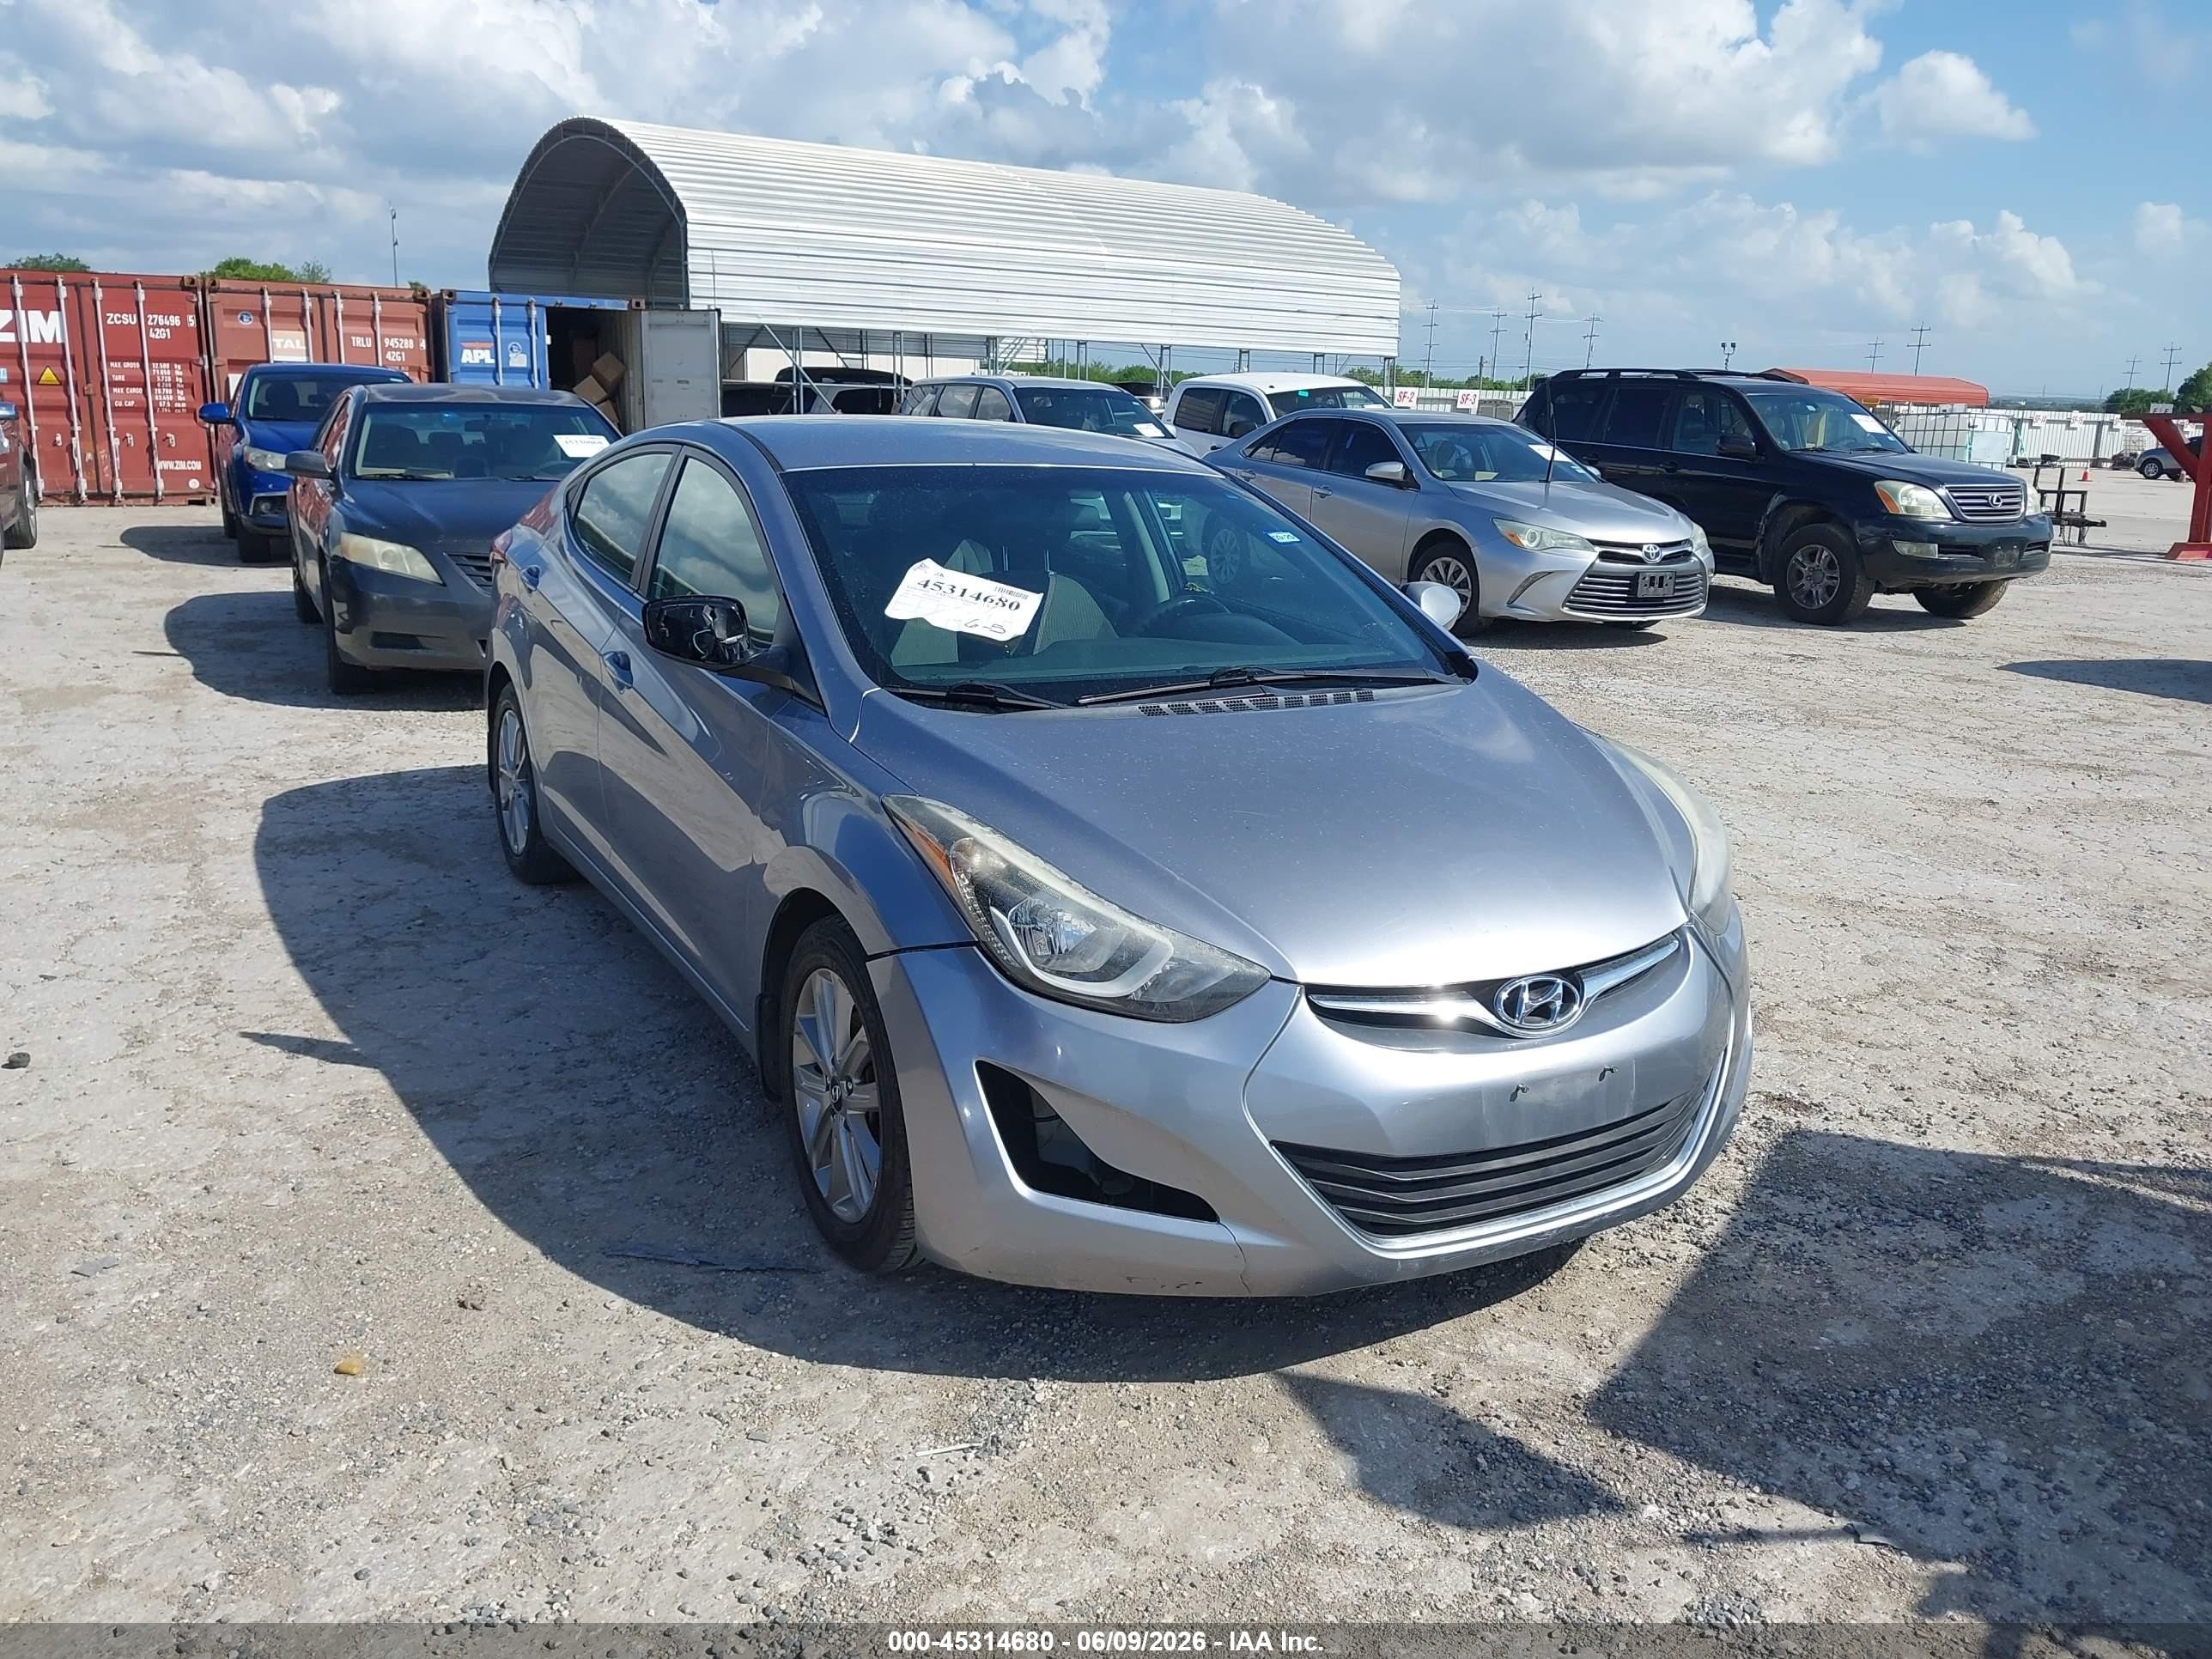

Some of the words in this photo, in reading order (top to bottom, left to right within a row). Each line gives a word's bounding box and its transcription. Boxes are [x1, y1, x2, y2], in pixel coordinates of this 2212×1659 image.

[0, 310, 65, 343] ZIM
[106, 313, 137, 325] ZCSU
[147, 314, 180, 326] 276496
[187, 315, 196, 327] 5
[149, 327, 171, 339] 42G1
[272, 338, 306, 349] TAL
[350, 336, 372, 348] TRLU
[384, 337, 414, 349] 945288
[419, 338, 427, 350] 4
[386, 350, 405, 362] 42G1
[461, 348, 495, 364] APL
[1396, 391, 1415, 403] SF-2
[1459, 393, 1477, 405] SF-3
[917, 579, 1021, 611] 45314680
